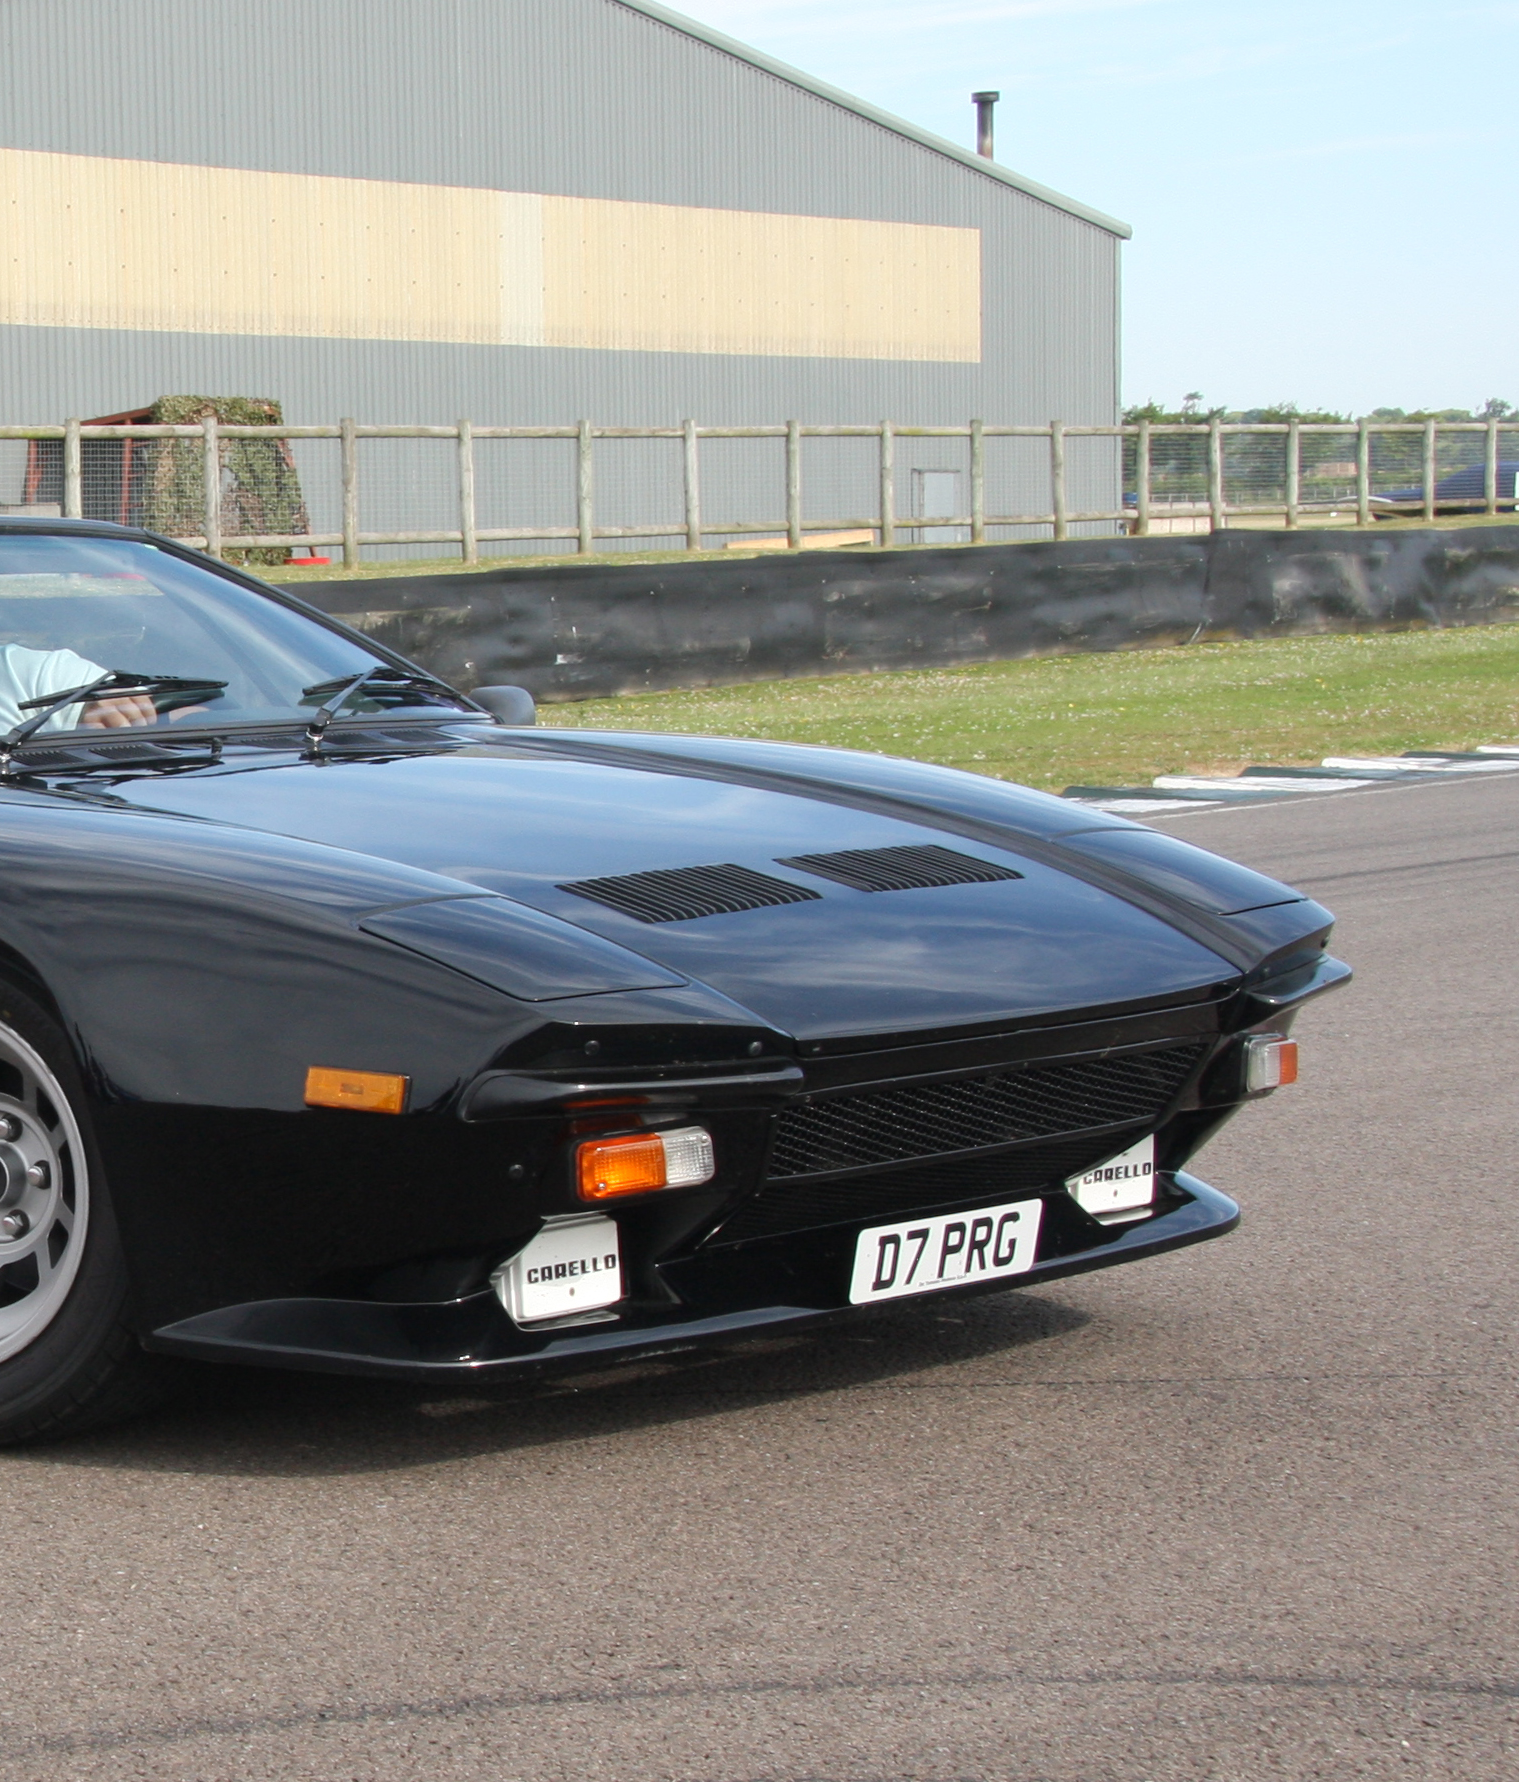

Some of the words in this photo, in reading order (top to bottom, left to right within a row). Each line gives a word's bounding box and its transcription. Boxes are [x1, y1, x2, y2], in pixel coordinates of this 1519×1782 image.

[1083, 1162, 1152, 1185] CARELLO
[871, 1227, 931, 1292] D7
[936, 1211, 1021, 1279] PRG
[527, 1253, 616, 1284] CARELLO
